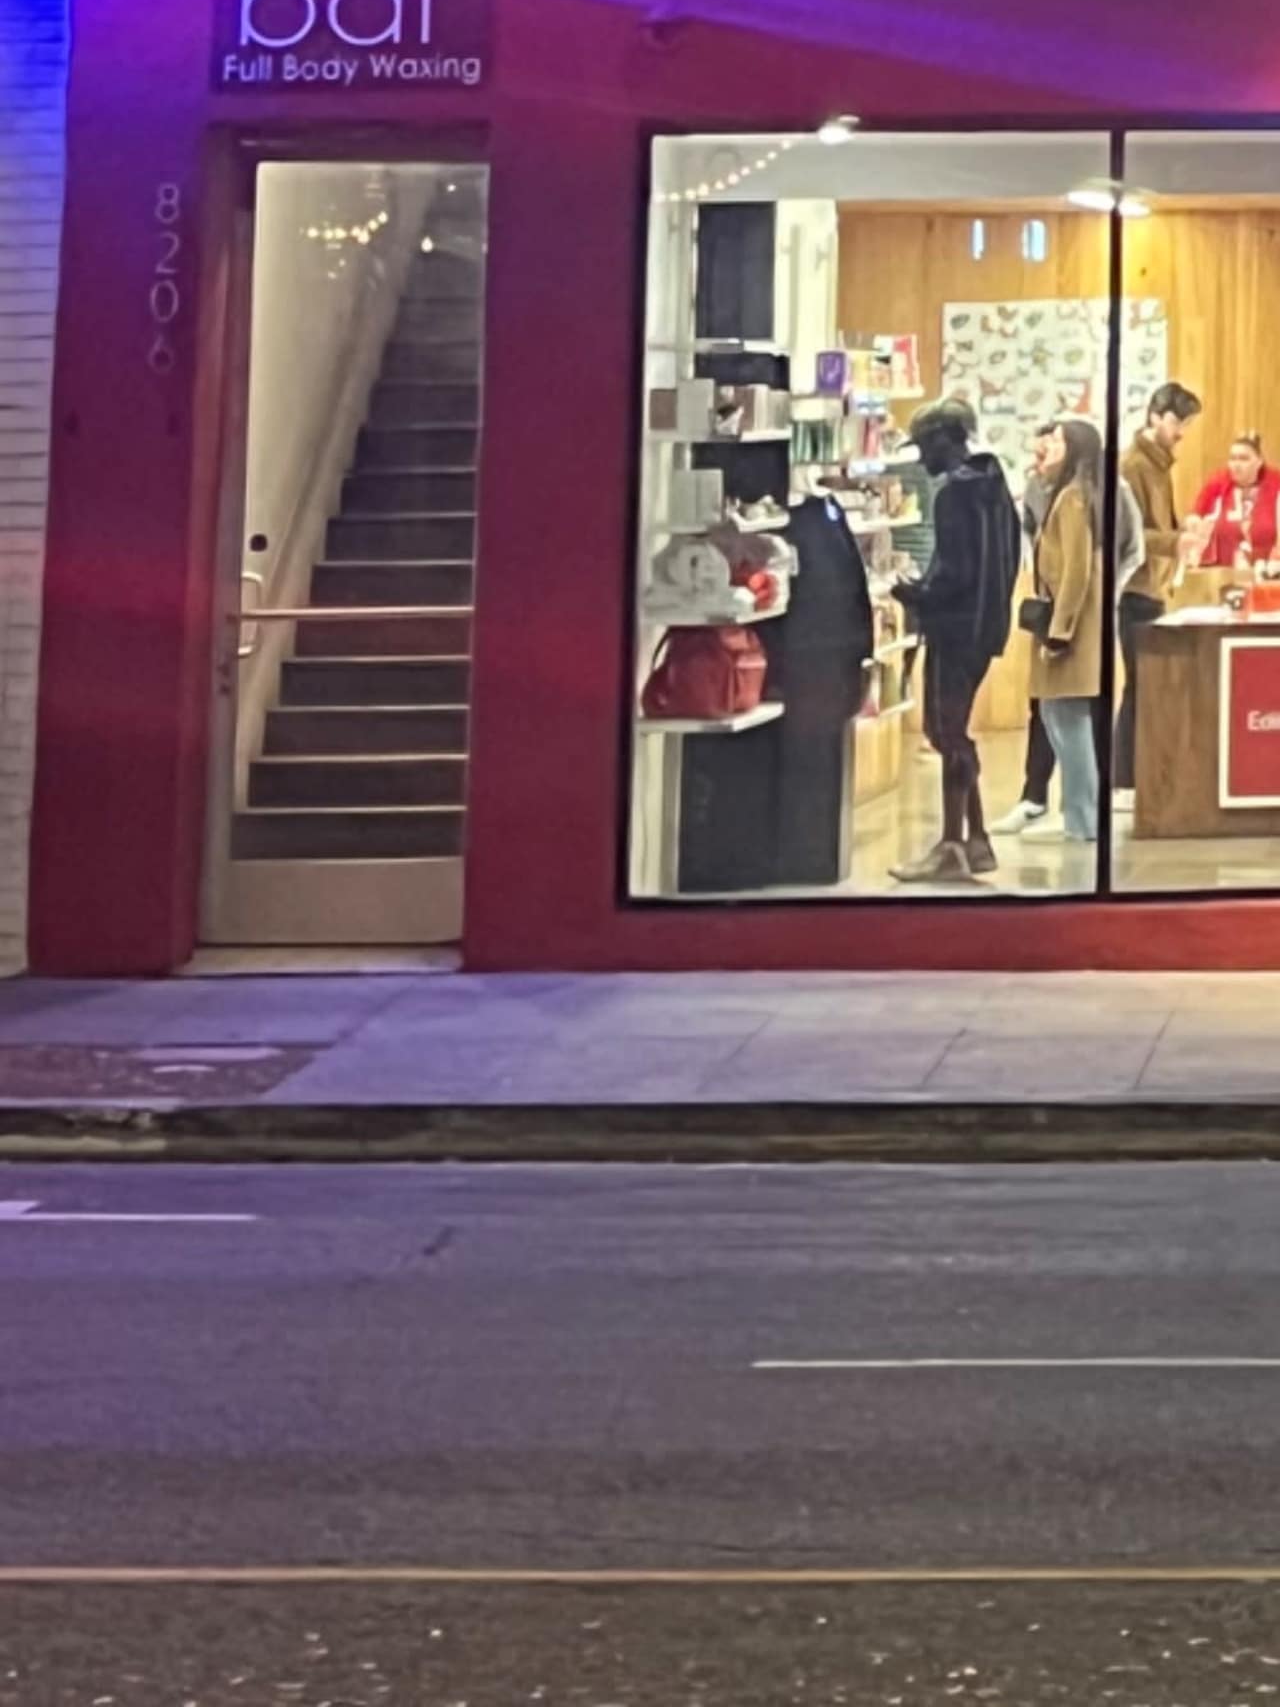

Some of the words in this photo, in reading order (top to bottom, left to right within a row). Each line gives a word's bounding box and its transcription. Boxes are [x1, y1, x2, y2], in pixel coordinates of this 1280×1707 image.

[223, 54, 273, 82] Full
[282, 53, 358, 85] Body
[369, 53, 481, 85] Waxing
[148, 182, 181, 375] 8206
